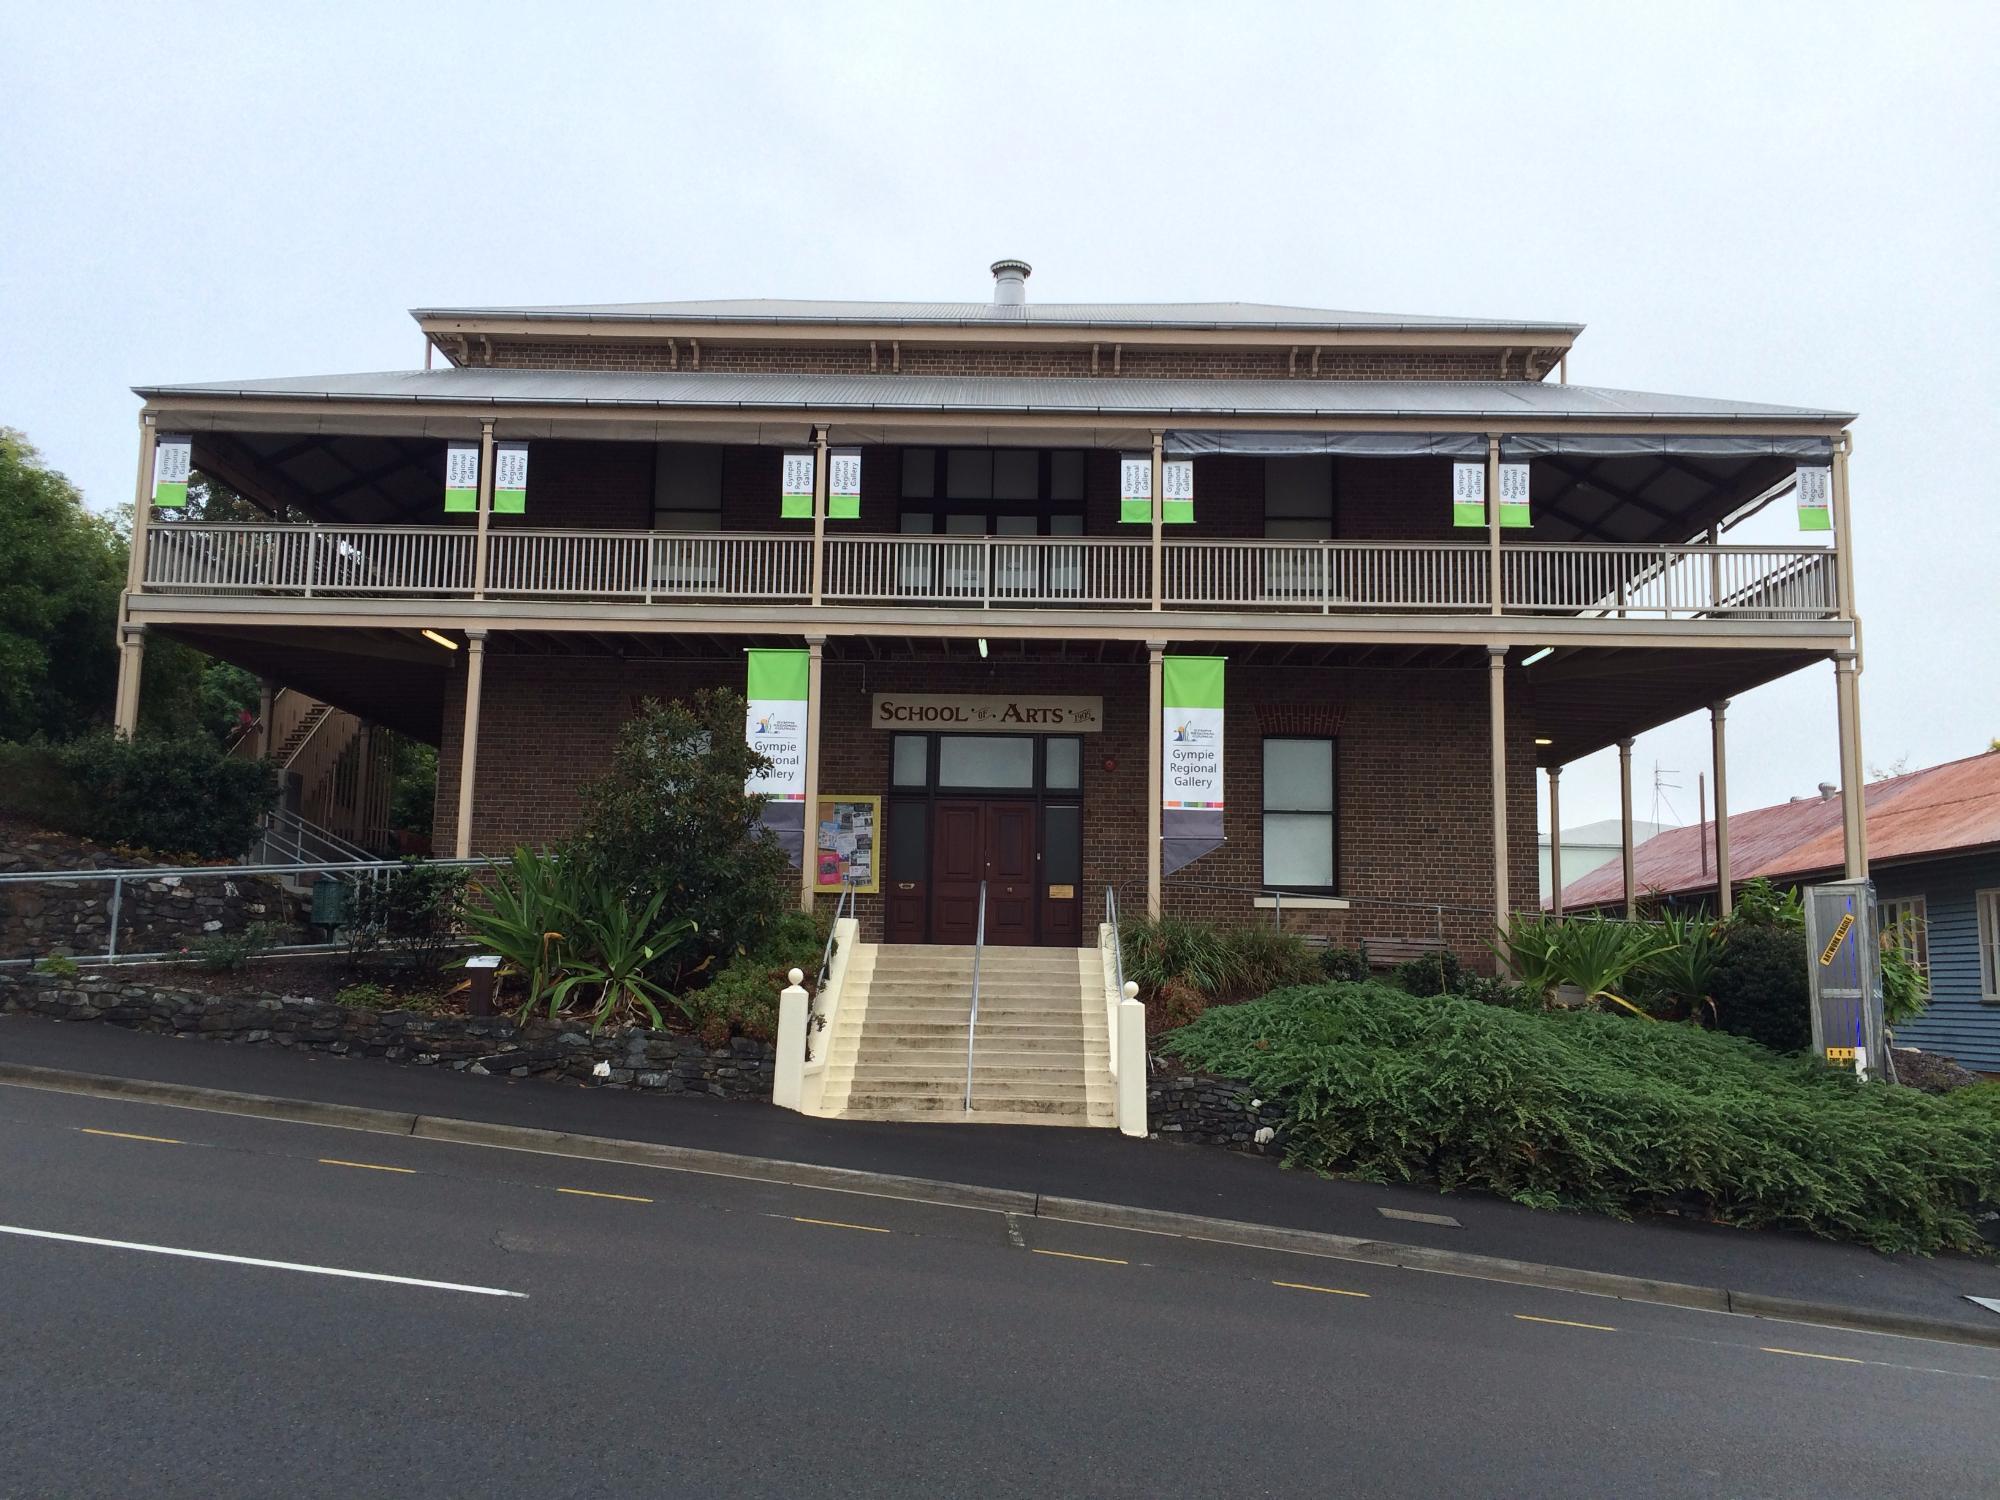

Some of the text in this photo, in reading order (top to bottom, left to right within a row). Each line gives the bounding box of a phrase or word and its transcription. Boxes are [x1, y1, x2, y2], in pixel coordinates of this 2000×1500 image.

[450, 455, 458, 480] Gympie
[459, 454, 467, 483] Regional
[468, 456, 476, 480] Gallery
[508, 455, 516, 484] Regional
[517, 457, 525, 481] Gallery
[786, 461, 794, 487] Gympie
[803, 462, 812, 486] Gallery
[834, 461, 842, 487] Gympie
[842, 460, 850, 489] Regional
[851, 462, 859, 487] Gallery
[1125, 465, 1133, 492] Gympie
[1133, 465, 1141, 494] Regional
[1142, 467, 1150, 490] Gallery
[1182, 468, 1191, 492] Gallery
[1457, 469, 1465, 495] Gympie
[1466, 468, 1474, 498] Regional
[1475, 470, 1483, 495] Gallery
[1519, 471, 1527, 495] Gallery
[1800, 472, 1808, 500] Gympie
[1809, 472, 1817, 502] Regional
[1818, 473, 1826, 499] Gallery
[1000, 703, 1064, 723] ARTS
[754, 741, 797, 753] Gympie
[1172, 749, 1215, 761] Gympie
[1170, 762, 1217, 775] Regional
[1174, 776, 1213, 789] Gallery
[1822, 916, 1853, 962] ARTWORK FRAGILE
